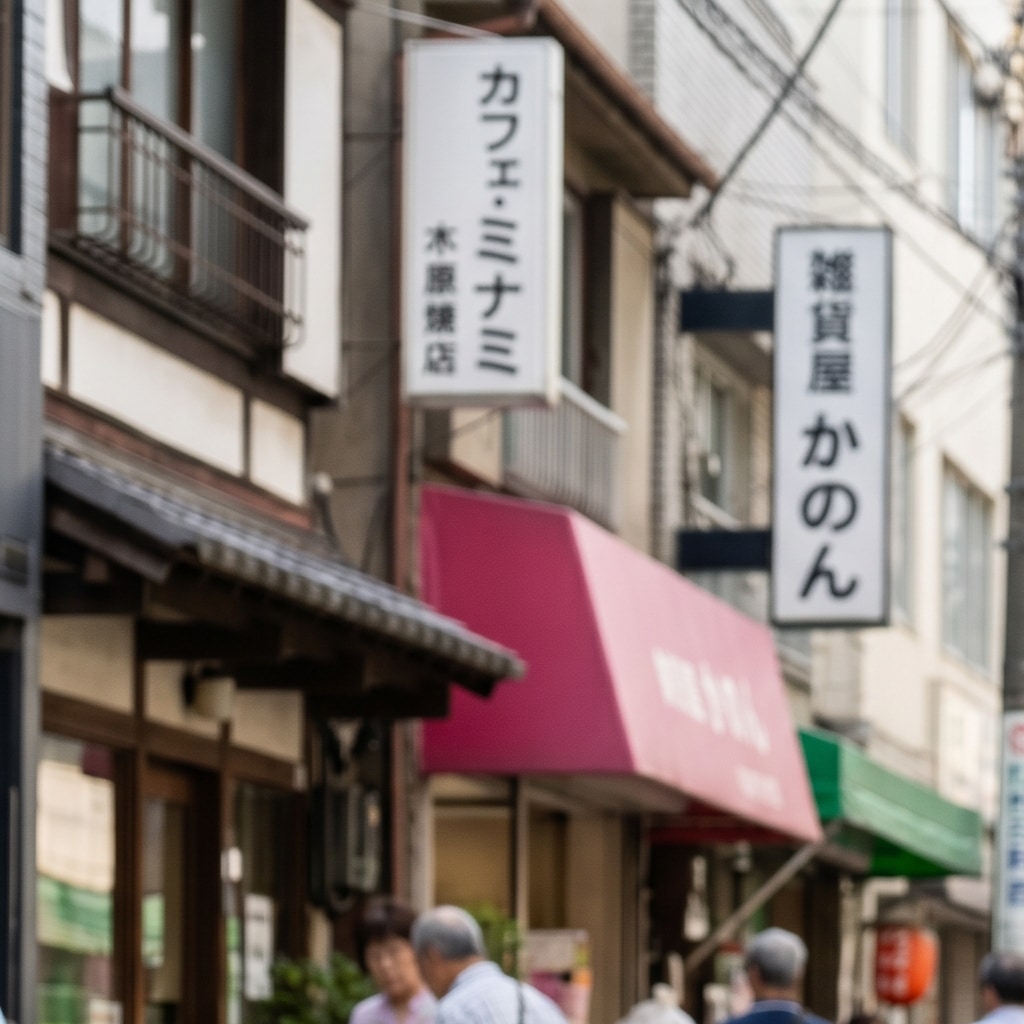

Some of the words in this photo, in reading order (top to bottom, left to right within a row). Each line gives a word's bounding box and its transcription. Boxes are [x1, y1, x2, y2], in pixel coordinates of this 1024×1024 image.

[474, 64, 520, 375] カフェ・ミナミ
